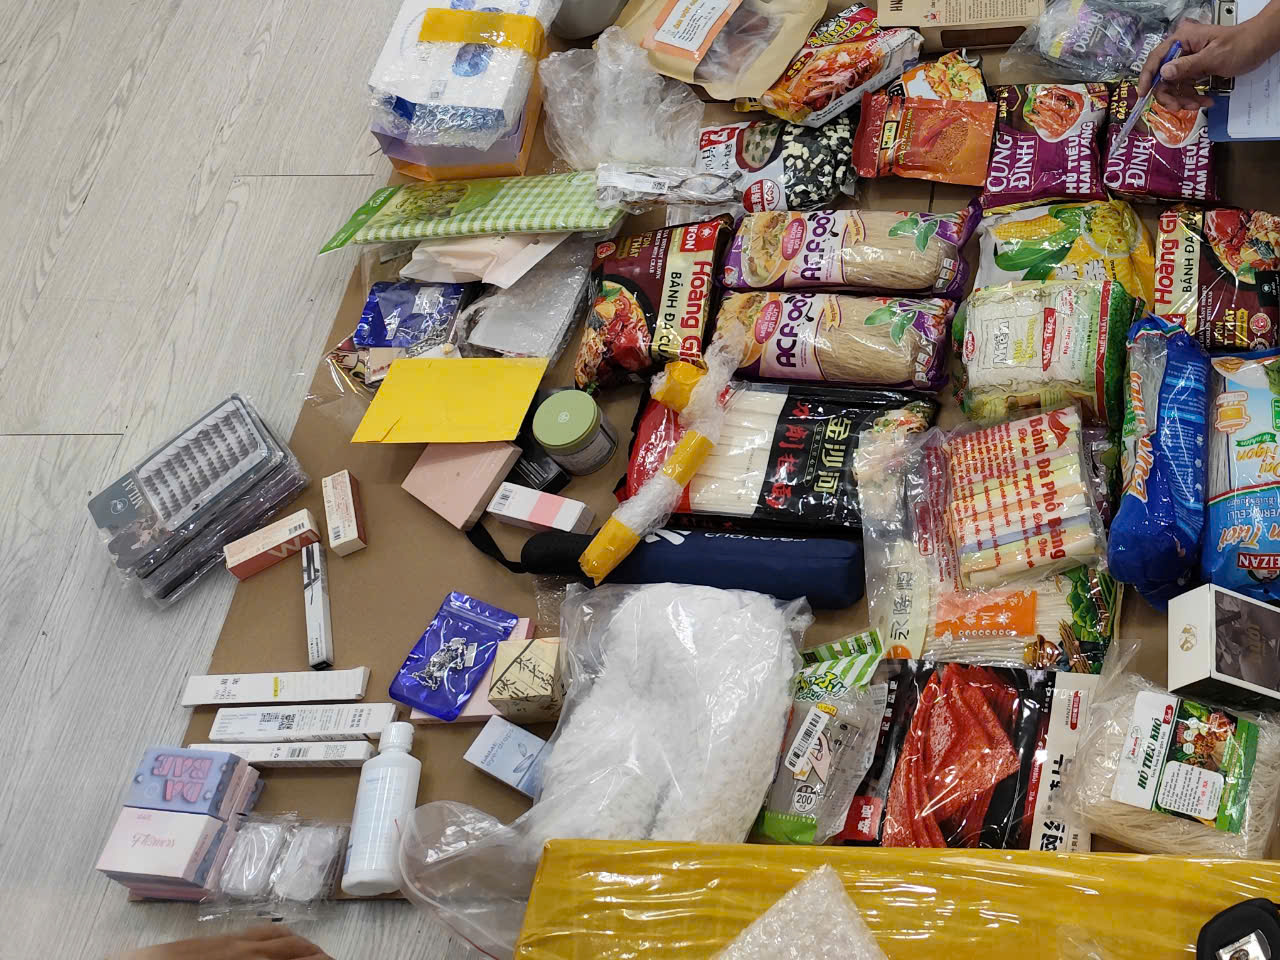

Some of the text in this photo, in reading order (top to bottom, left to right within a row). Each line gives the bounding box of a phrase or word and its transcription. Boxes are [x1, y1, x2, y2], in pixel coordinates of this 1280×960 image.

[1073, 12, 1104, 53] Downy
[985, 132, 1014, 192] CUNG
[1009, 139, 1036, 189] ĐÌNH
[1064, 135, 1079, 169] TIẾU
[1079, 120, 1094, 194] NAM VANG
[1124, 136, 1154, 188] ĐÌNH
[1181, 142, 1198, 178] TIẾU
[1195, 124, 1210, 200] NAM VANG
[1153, 236, 1181, 307] Hoàng
[1181, 235, 1196, 294] BÁNH ĐA
[662, 271, 682, 309] BÁNH
[680, 260, 713, 330] Hoàng
[813, 416, 853, 495] 金沙河
[1236, 443, 1280, 463] Ngon
[121, 477, 146, 511] MILAI
[1029, 416, 1070, 560] Bánh Đá Phố Bảng
[1217, 523, 1263, 553] Tươi
[1146, 717, 1164, 742] KHÔ
[1136, 741, 1158, 770] TIẾU
[795, 793, 813, 806] 200
[1133, 769, 1150, 790] HỦ
